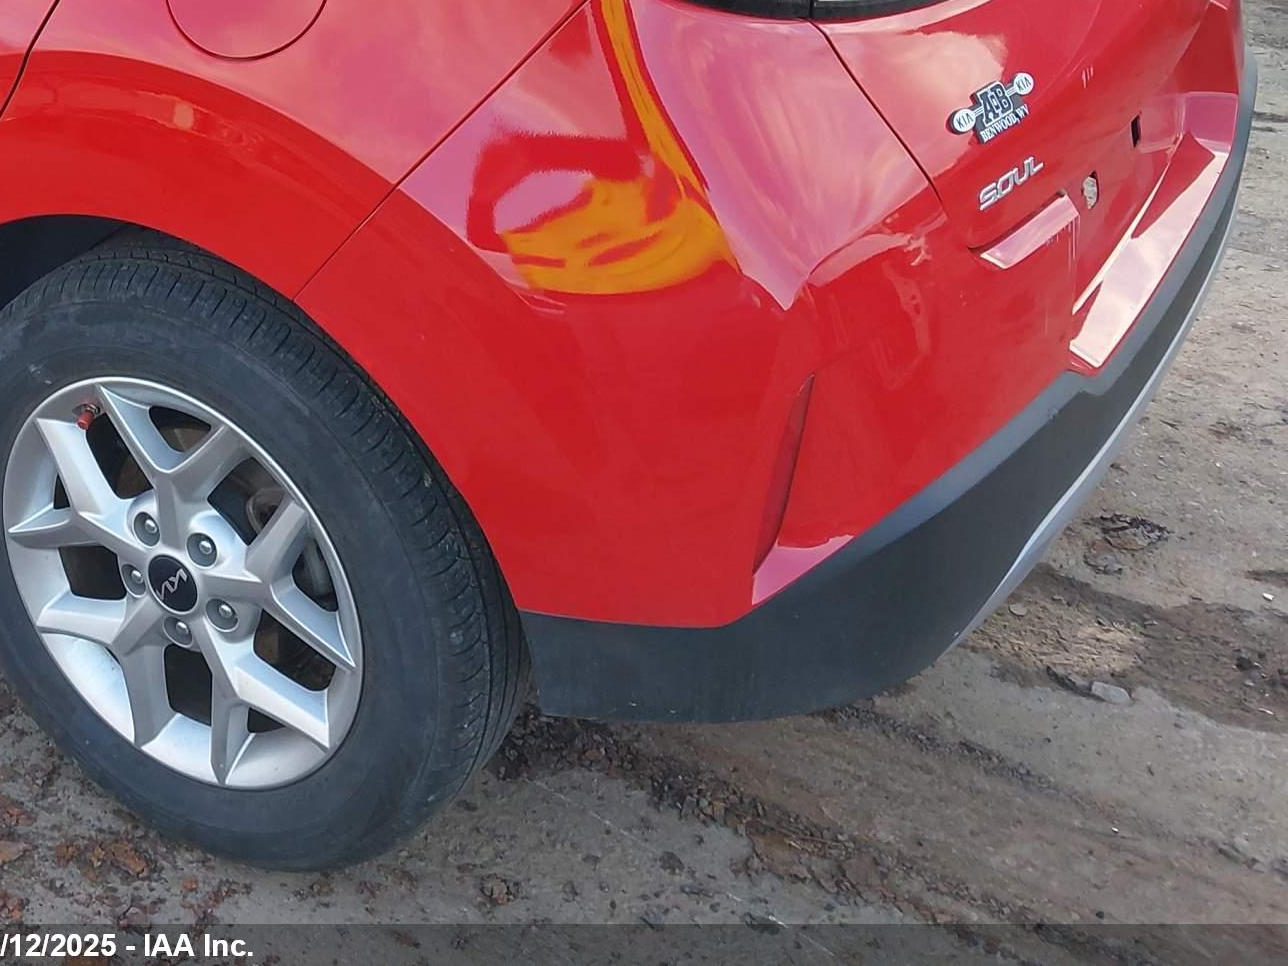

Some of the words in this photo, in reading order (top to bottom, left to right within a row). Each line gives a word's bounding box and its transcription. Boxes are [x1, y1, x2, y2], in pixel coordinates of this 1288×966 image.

[955, 112, 974, 132] KIA
[1015, 76, 1032, 93] KIA
[979, 156, 1044, 211] SOUL
